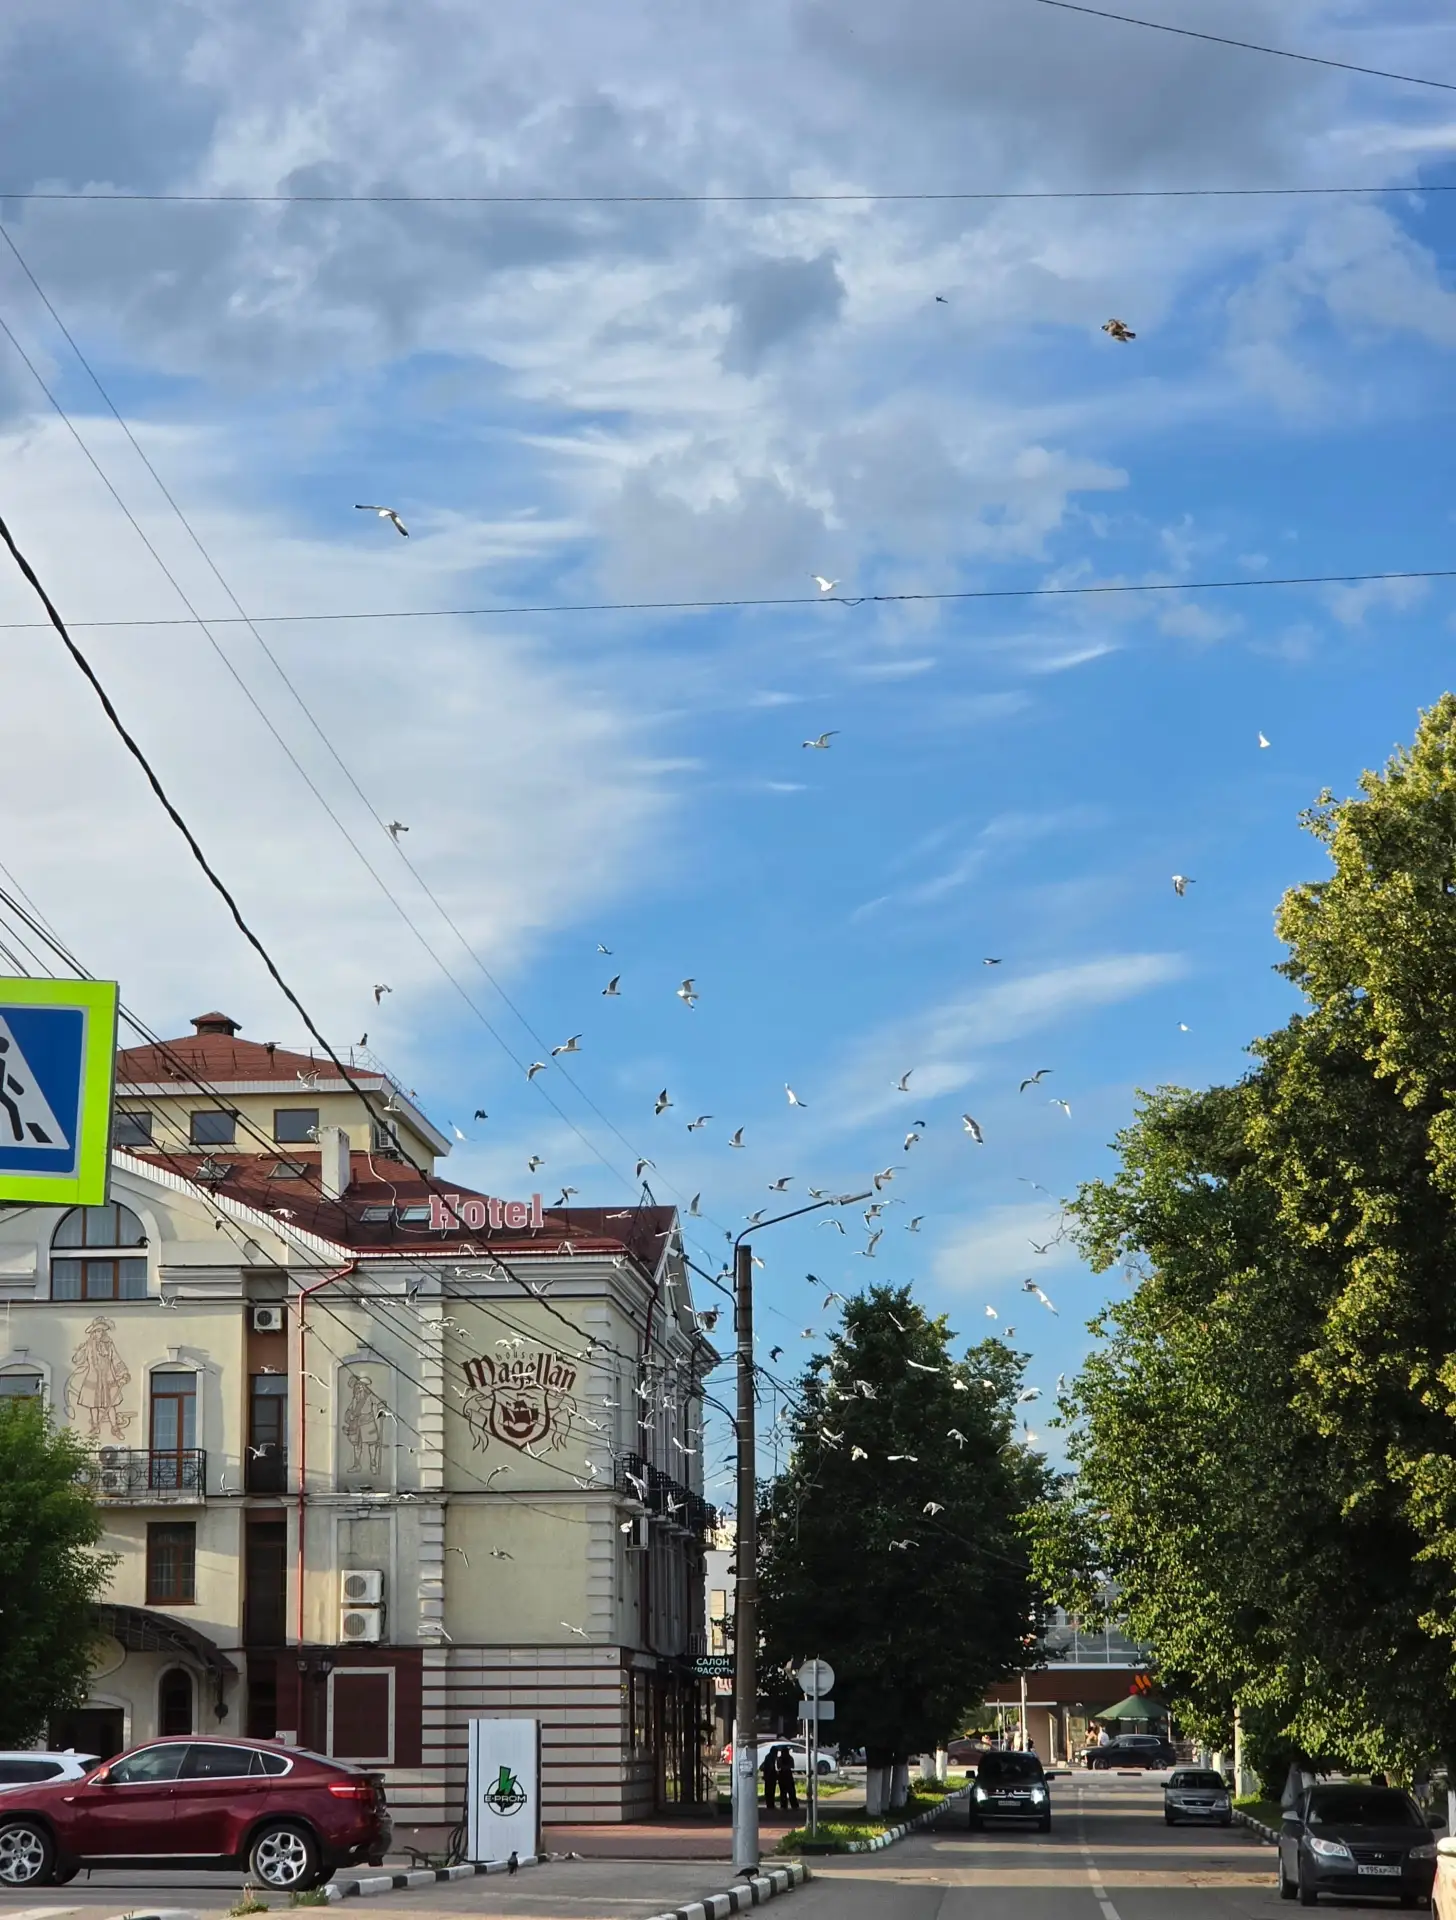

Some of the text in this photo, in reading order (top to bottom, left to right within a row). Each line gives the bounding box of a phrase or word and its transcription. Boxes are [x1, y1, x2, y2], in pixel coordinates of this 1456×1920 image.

[429, 1193, 543, 1229] Hotel
[495, 1349, 534, 1361] house
[461, 1353, 577, 1391] Magellan
[691, 1666, 735, 1675] РАСОТЫ
